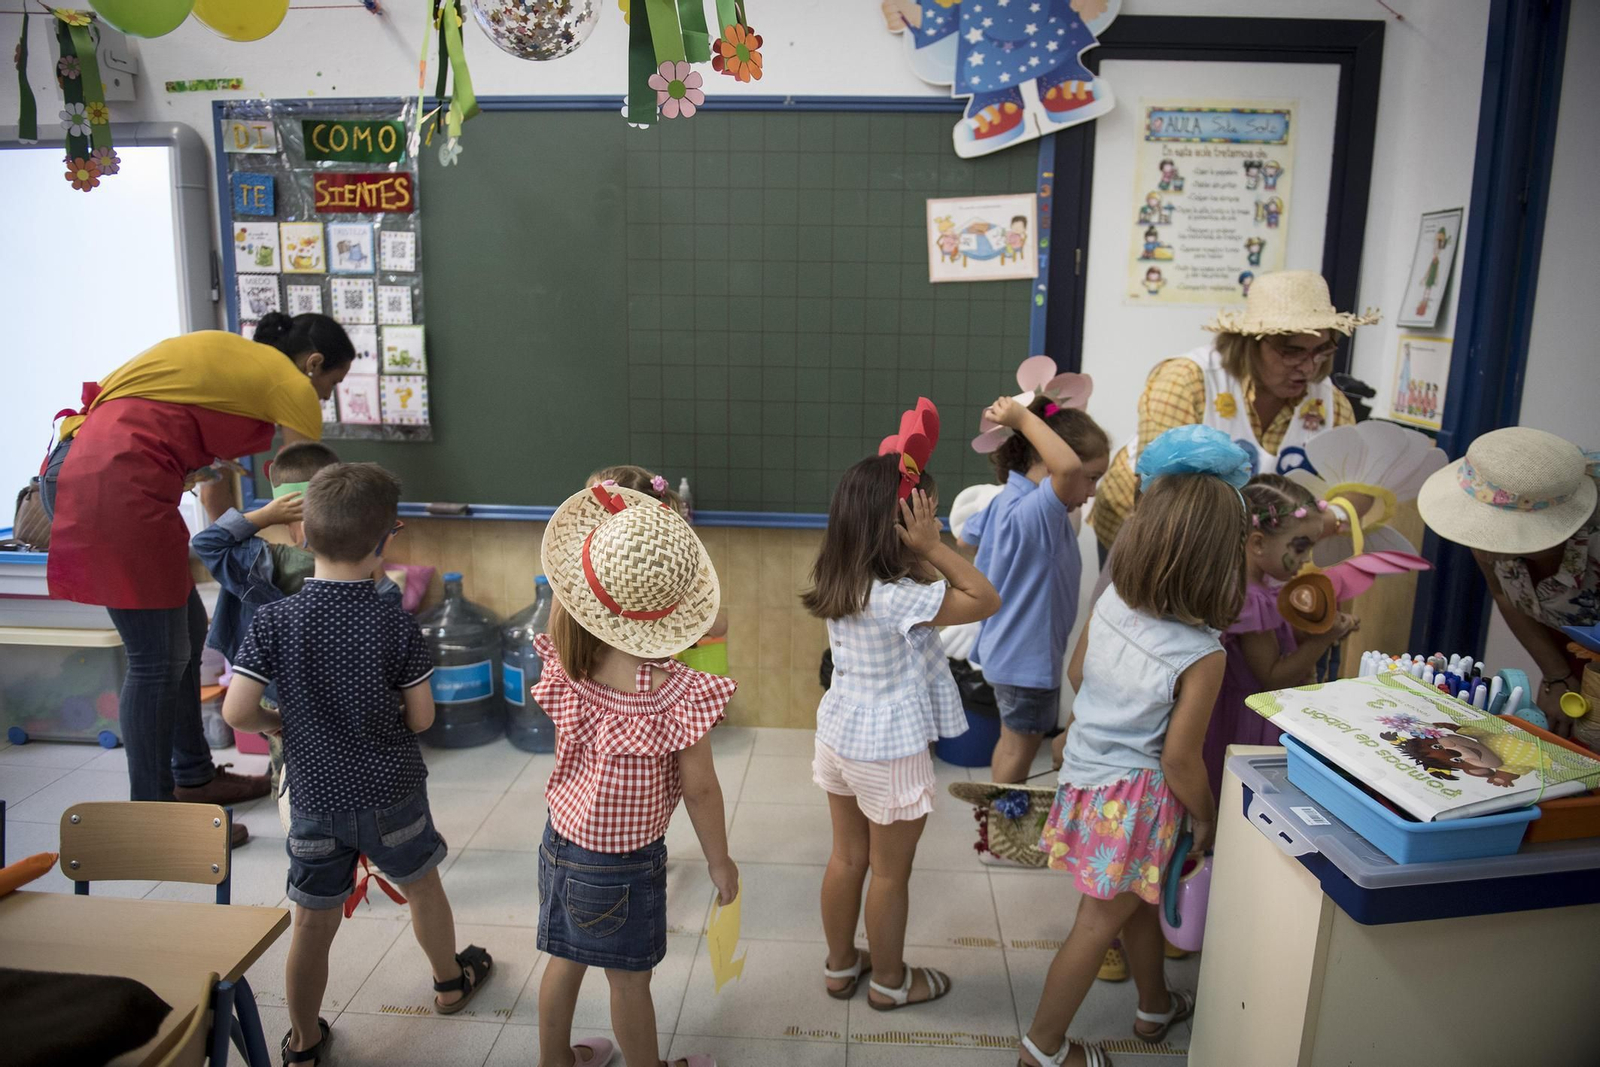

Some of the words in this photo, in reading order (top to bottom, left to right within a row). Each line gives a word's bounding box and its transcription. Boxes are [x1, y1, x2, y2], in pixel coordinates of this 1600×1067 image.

[1165, 116, 1202, 134] AULA
[233, 123, 270, 150] DI
[312, 124, 397, 153] COMO
[240, 184, 266, 207] TE
[315, 177, 411, 210] SIENTES
[1366, 698, 1398, 710] 3
[1354, 733, 1380, 748] de
[1375, 749, 1463, 798] pompas
